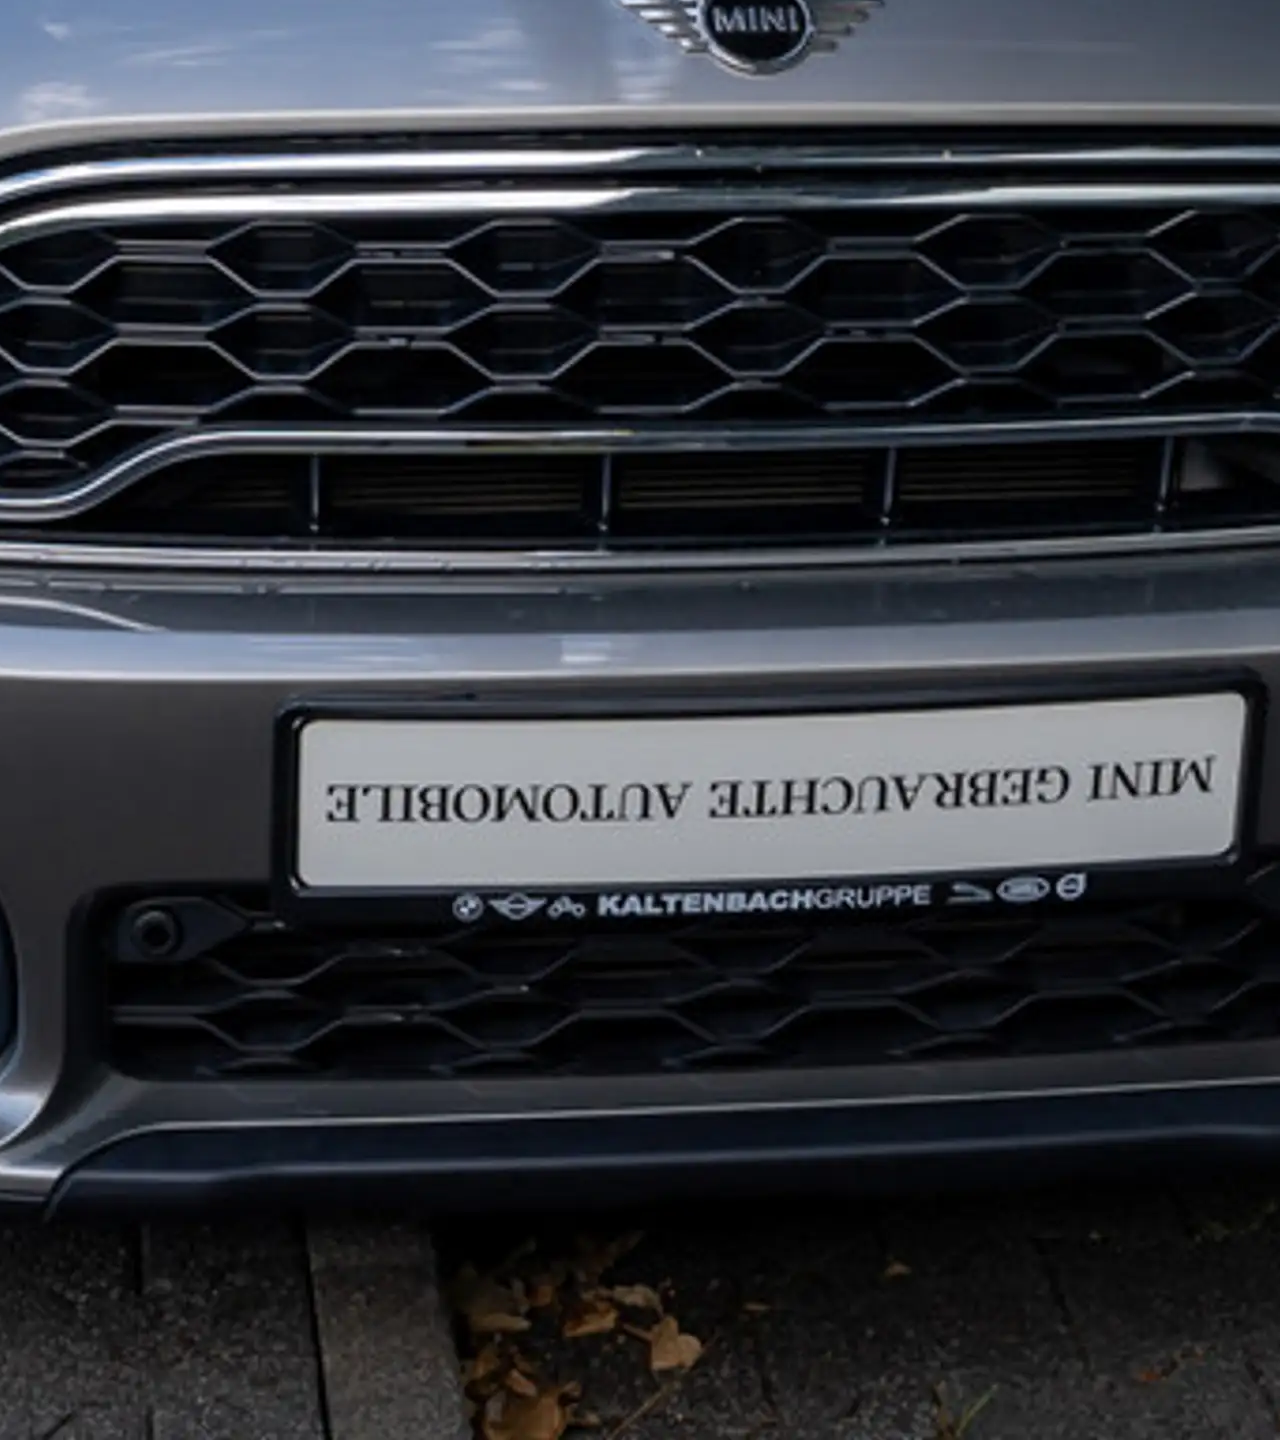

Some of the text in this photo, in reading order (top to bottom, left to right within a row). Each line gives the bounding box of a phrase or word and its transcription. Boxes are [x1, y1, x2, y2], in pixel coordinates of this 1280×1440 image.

[711, 5, 800, 33] MINI
[325, 754, 1217, 823] MINI GEBRAUCHTE AUTOMOBILE
[597, 884, 932, 917] KALTENBACHGRUPPE
